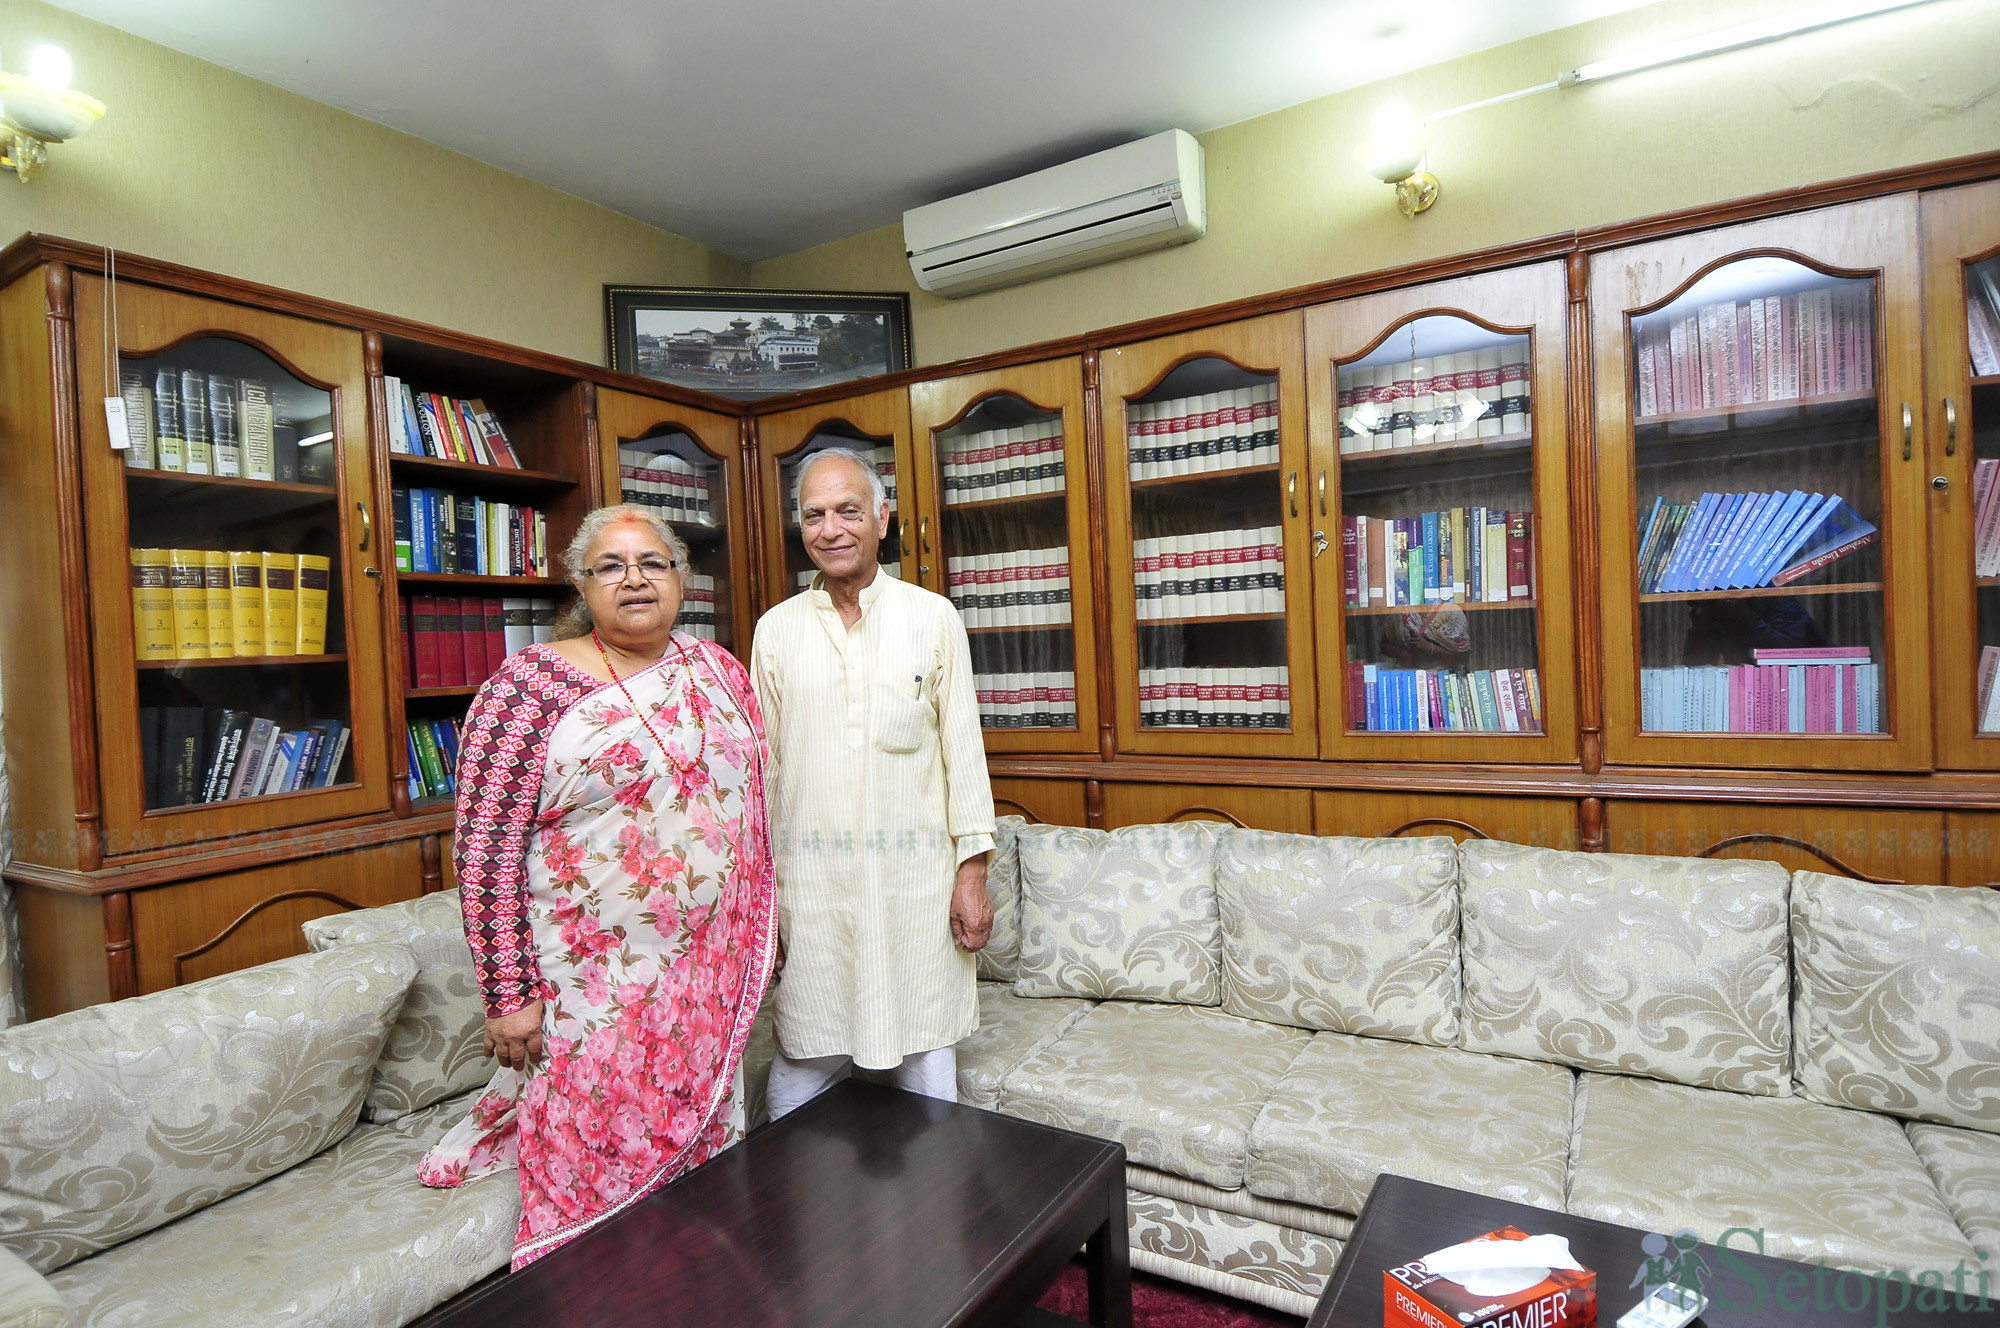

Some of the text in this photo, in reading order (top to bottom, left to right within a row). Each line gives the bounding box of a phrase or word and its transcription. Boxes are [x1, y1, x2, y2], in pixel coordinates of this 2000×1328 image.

[247, 389, 268, 464] CONVEYANCING
[513, 528, 522, 568] DICTIONARY
[1811, 535, 1871, 566] Abraham Lincoln
[242, 748, 262, 789] CRIMINAL
[1474, 1307, 1490, 1319] 100
[1475, 1291, 1567, 1328] EMIER
